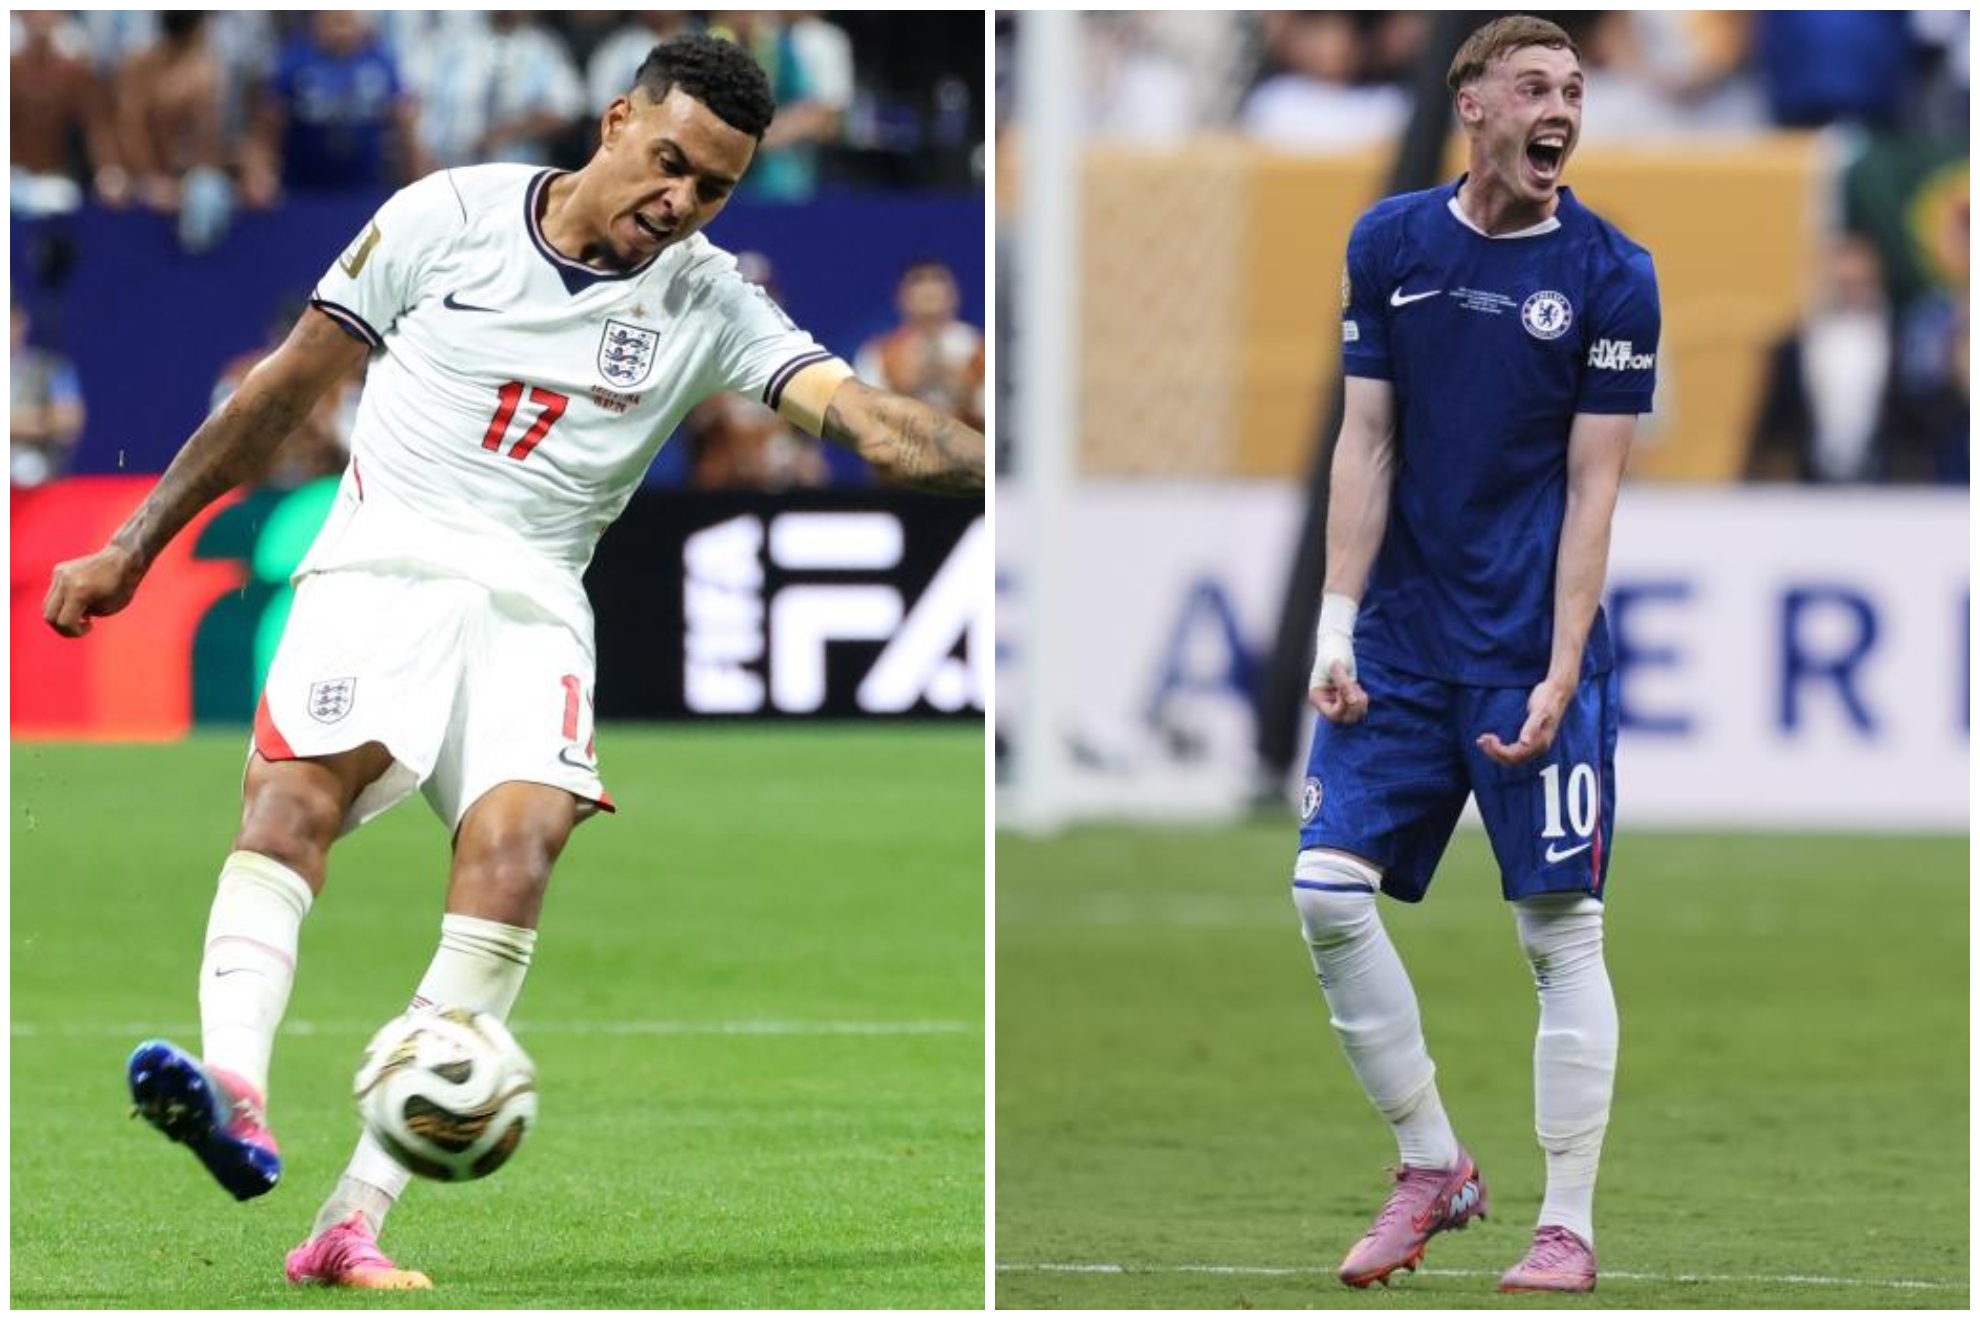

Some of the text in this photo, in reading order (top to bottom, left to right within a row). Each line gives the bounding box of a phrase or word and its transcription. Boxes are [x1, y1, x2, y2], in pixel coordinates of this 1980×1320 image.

[1587, 352, 1656, 371] NATION
[1590, 339, 1632, 359] LIVE
[482, 380, 569, 461] 17
[684, 514, 763, 713] FIFA
[560, 674, 595, 761] 1
[1539, 763, 1597, 838] 10
